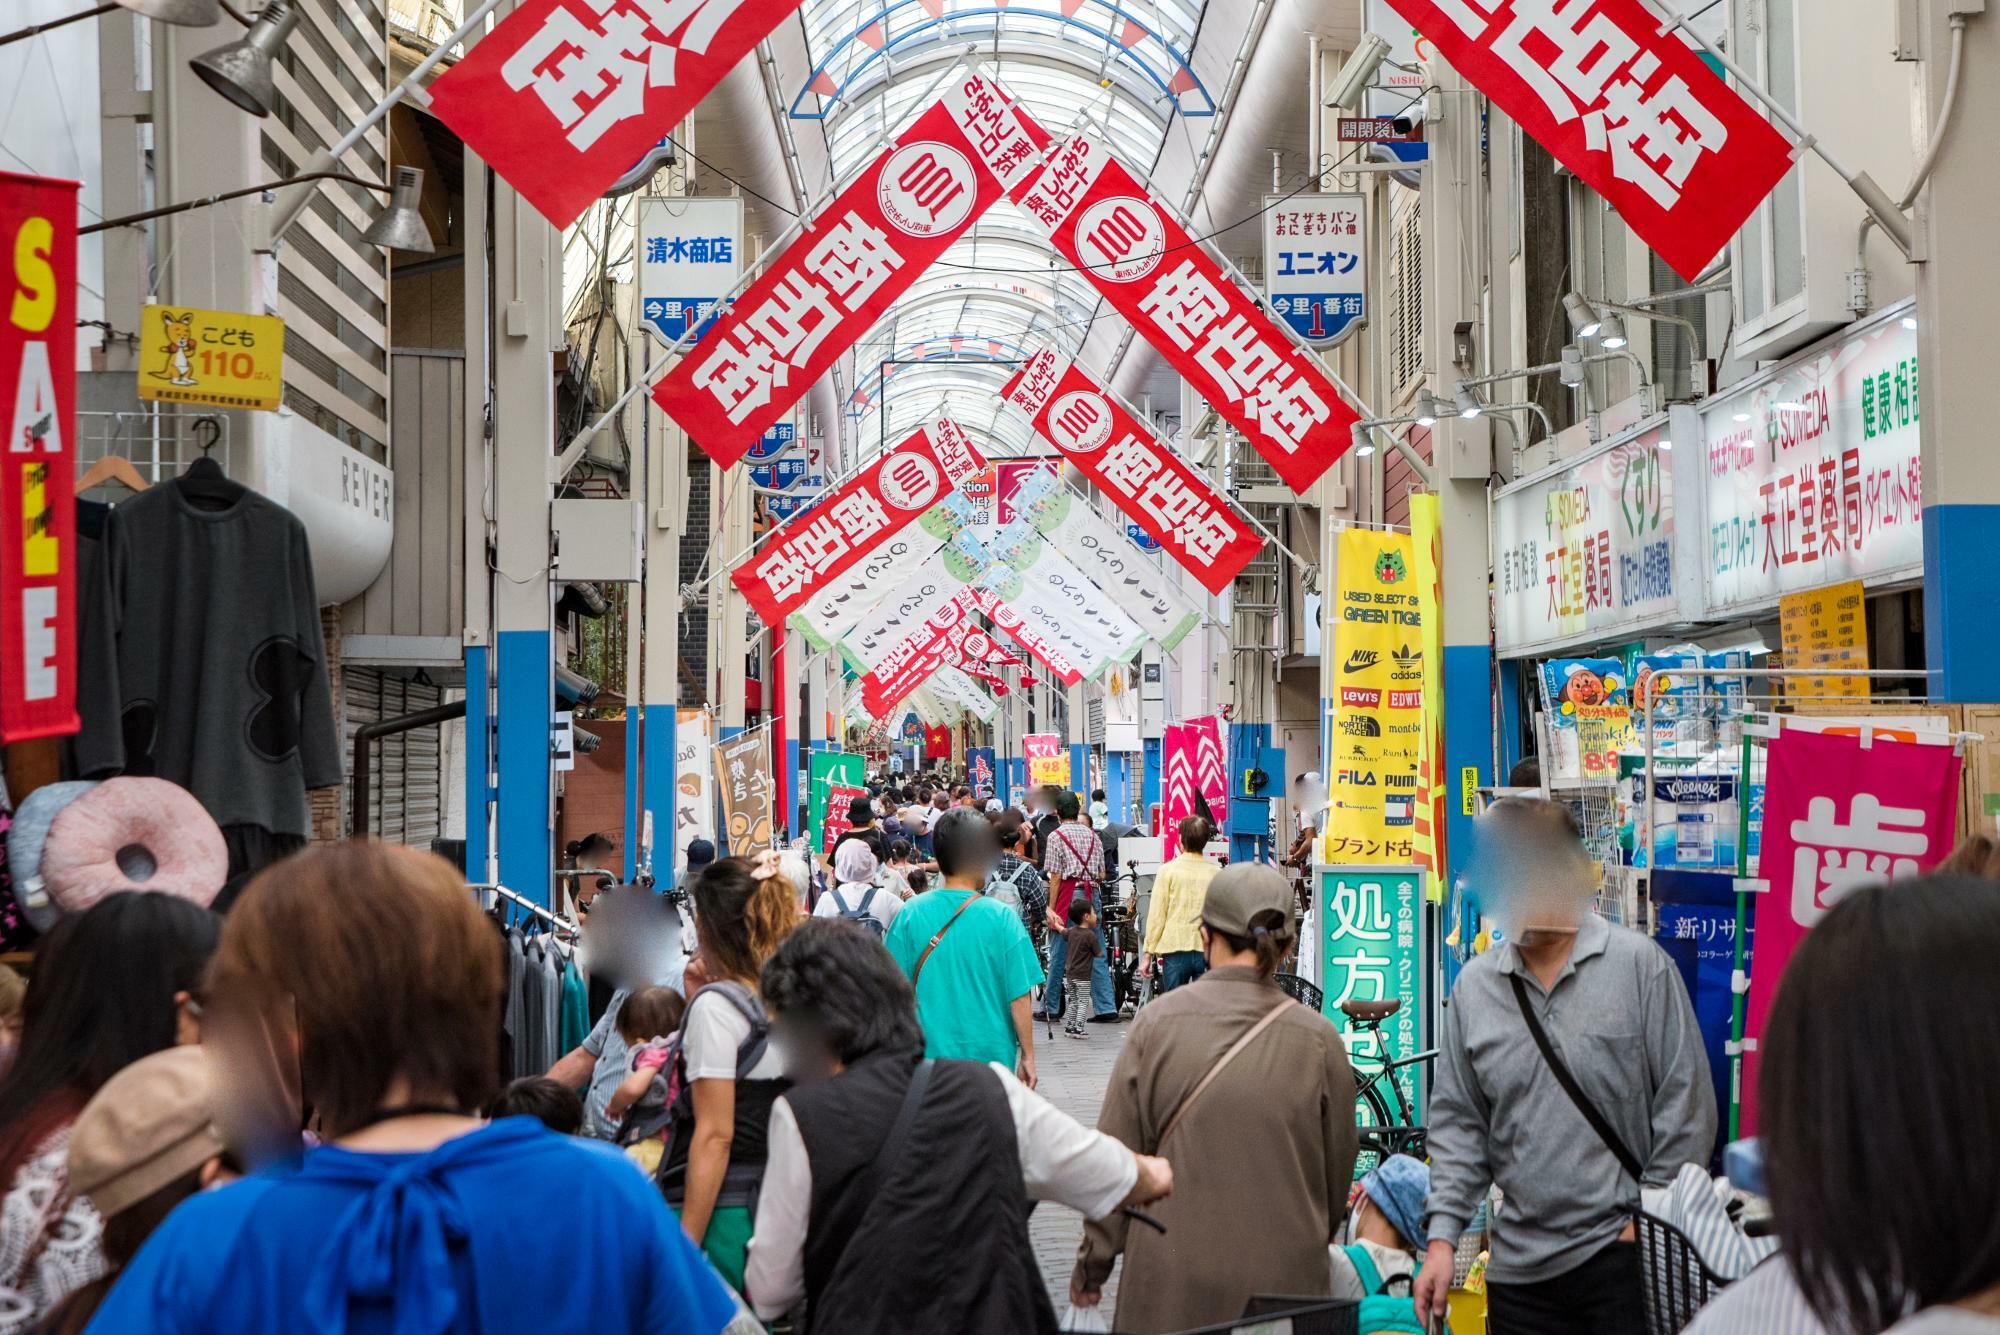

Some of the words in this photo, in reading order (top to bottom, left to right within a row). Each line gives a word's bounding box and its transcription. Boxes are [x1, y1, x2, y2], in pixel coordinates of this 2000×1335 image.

[1275, 211, 1358, 224] ヤマザキパン
[1275, 224, 1358, 236] おにぎり小僧
[1086, 205, 1147, 269] 100
[647, 237, 732, 264] 清水商店
[1277, 251, 1358, 275] ユニオン
[202, 327, 255, 348] こども
[200, 350, 255, 380] 110
[1136, 259, 1332, 455] 商店街
[1056, 397, 1099, 443] 100
[9, 217, 63, 701] SALE
[1094, 432, 1238, 568] 商店街
[1622, 446, 1661, 538] くすり
[1866, 456, 1922, 534] ダイエット相
[1558, 484, 1591, 531] SOMEDA
[1760, 447, 1863, 574] 天正堂薬局
[1545, 529, 1612, 622] 天正堂薬局
[1343, 591, 1372, 602] USED
[1374, 594, 1406, 605] SELECT
[1343, 606, 1389, 624] GREEN
[1350, 650, 1379, 664] NIKE
[1390, 671, 1422, 680] adidas
[1339, 721, 1368, 730] NORTH
[1338, 770, 1377, 785] FILA
[1385, 775, 1417, 787] PUM
[1667, 779, 1720, 798] Kleenex
